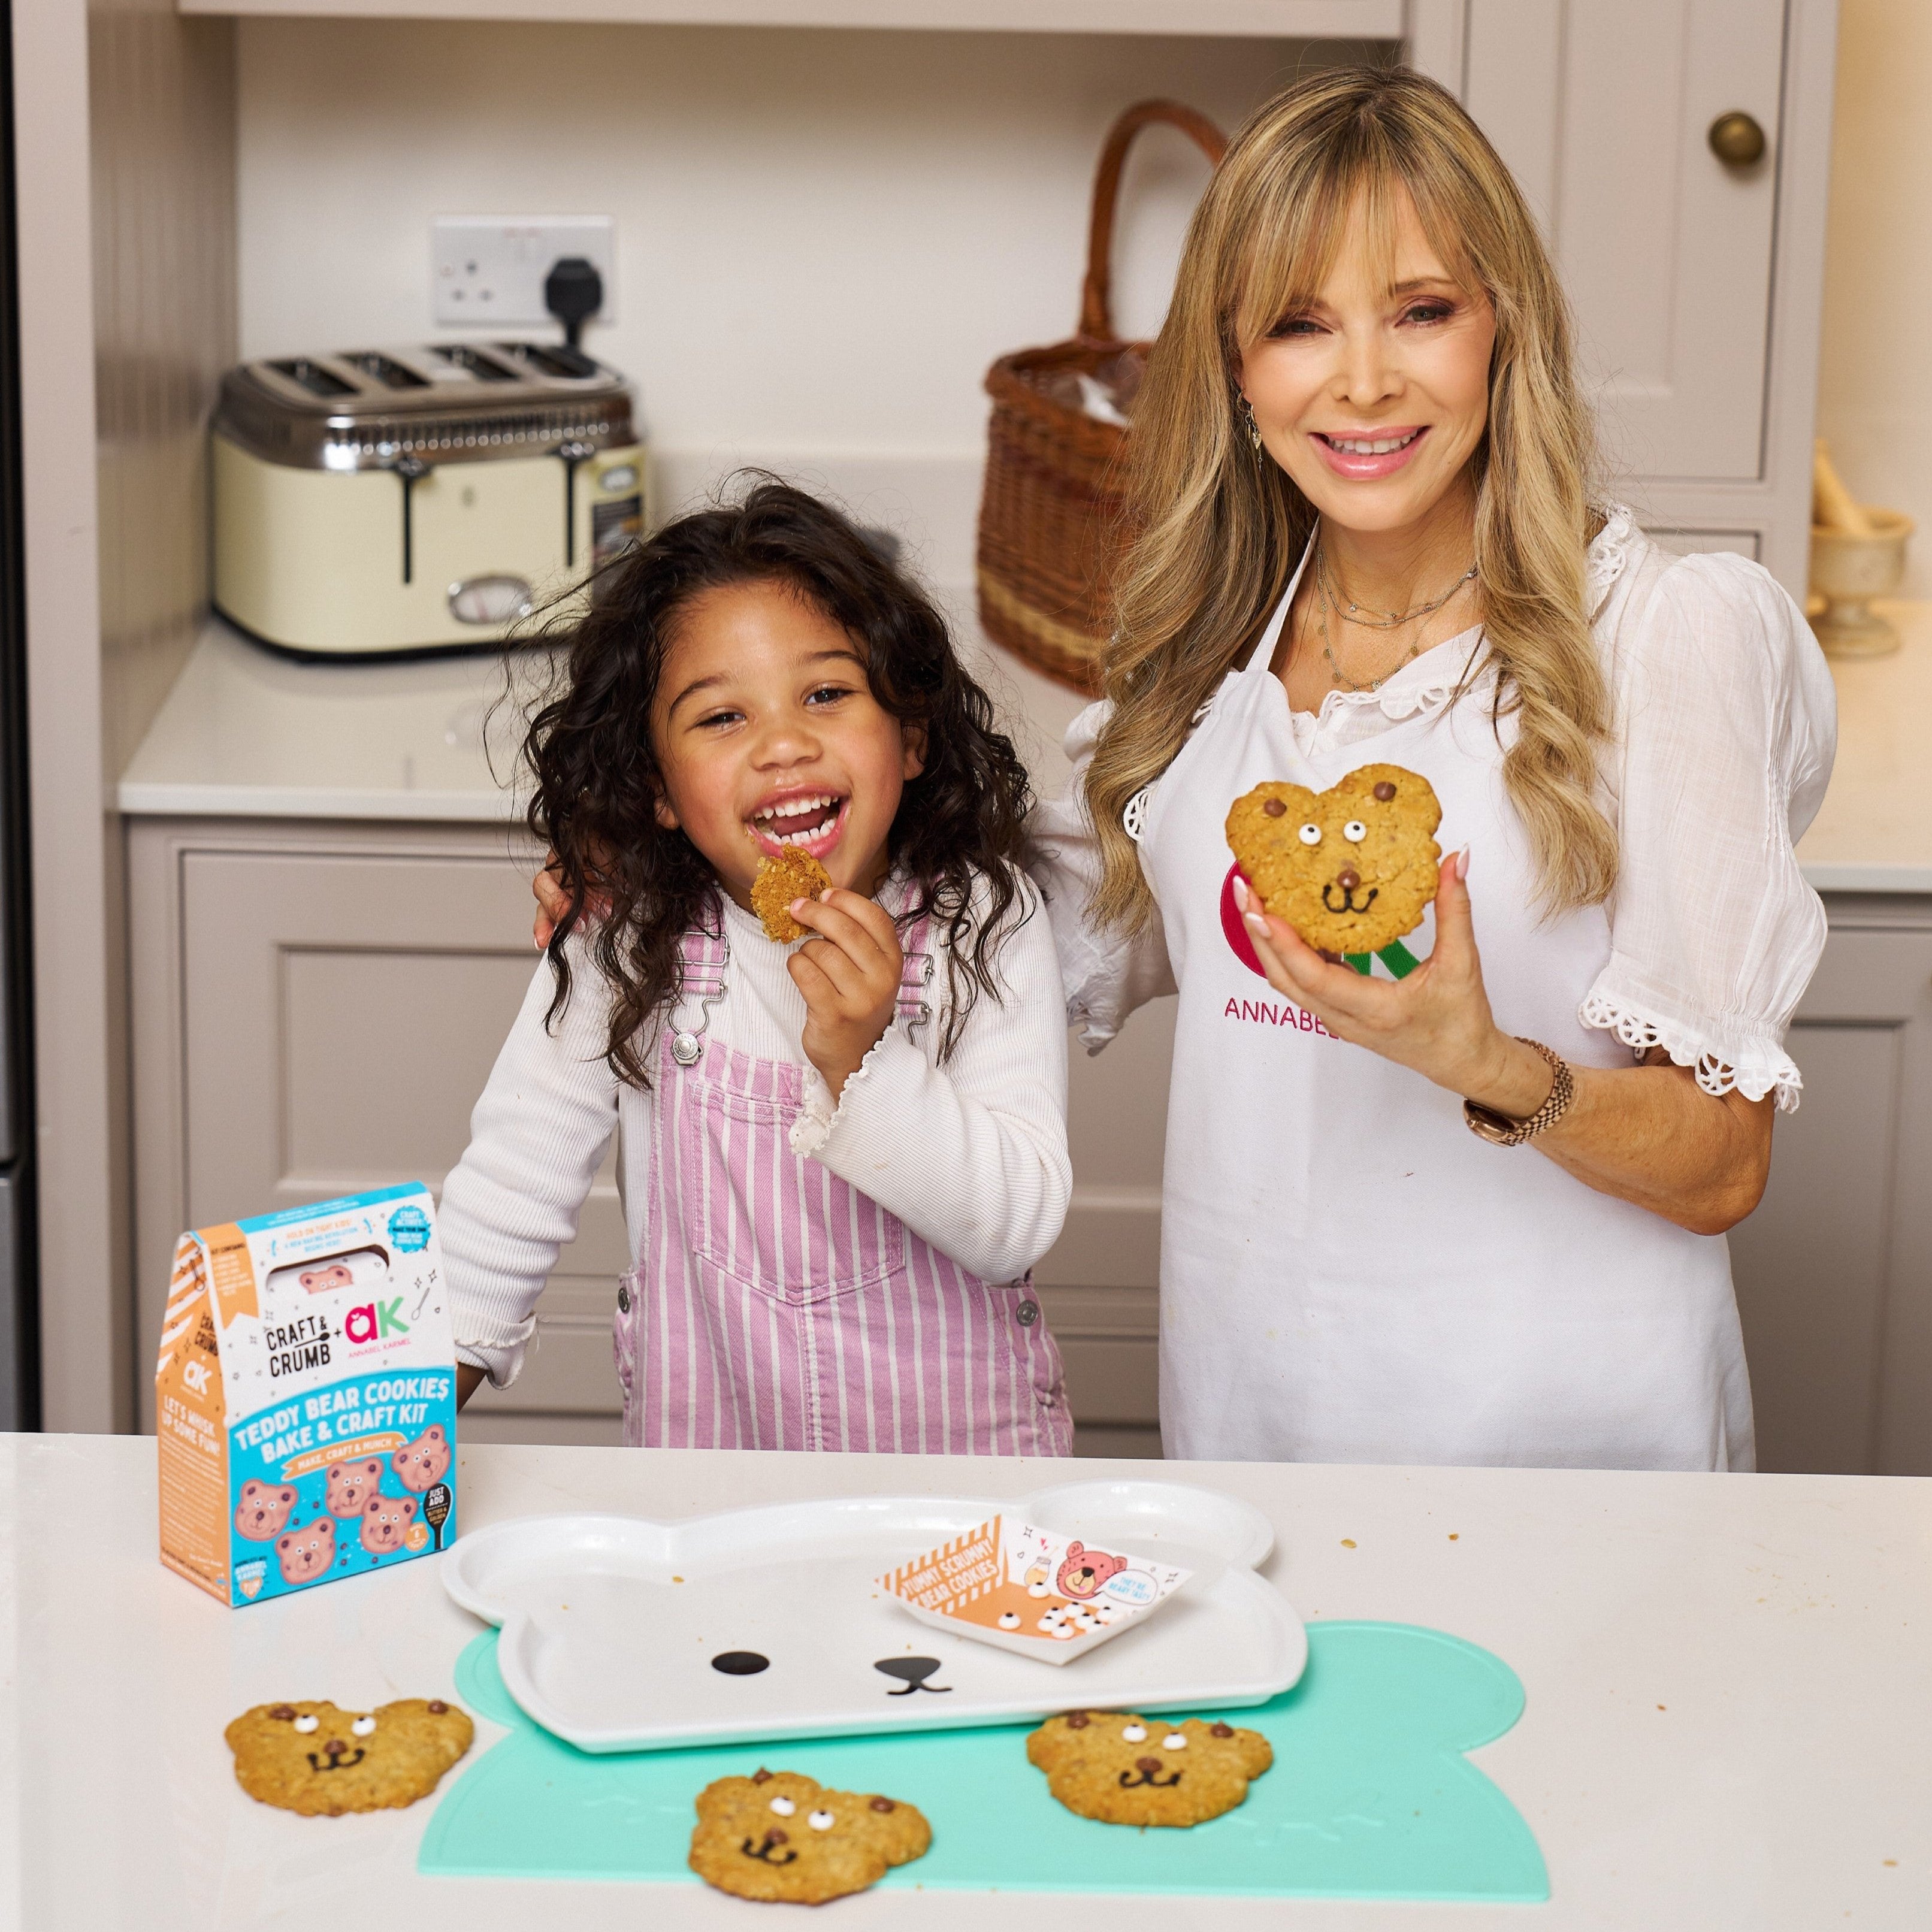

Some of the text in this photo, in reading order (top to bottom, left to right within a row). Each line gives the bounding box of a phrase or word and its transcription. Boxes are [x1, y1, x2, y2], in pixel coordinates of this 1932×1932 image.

[1224, 997, 1340, 1040] ANNABE
[267, 1316, 328, 1351] CRAFT &
[348, 1338, 412, 1359] ANNABEL KARMEL
[270, 1343, 331, 1377] CRUMB
[234, 1377, 450, 1451] TEDDY BEAR COOKIES
[261, 1403, 429, 1464] BAKE & CRAFT KIT
[325, 1445, 353, 1461] CRAFT
[362, 1438, 392, 1450] MUNCH
[429, 1486, 445, 1498] JUST
[429, 1495, 445, 1507] ADD
[901, 1537, 994, 1595] YUMMY SCRUMMY
[948, 1558, 999, 1594] COOKIES
